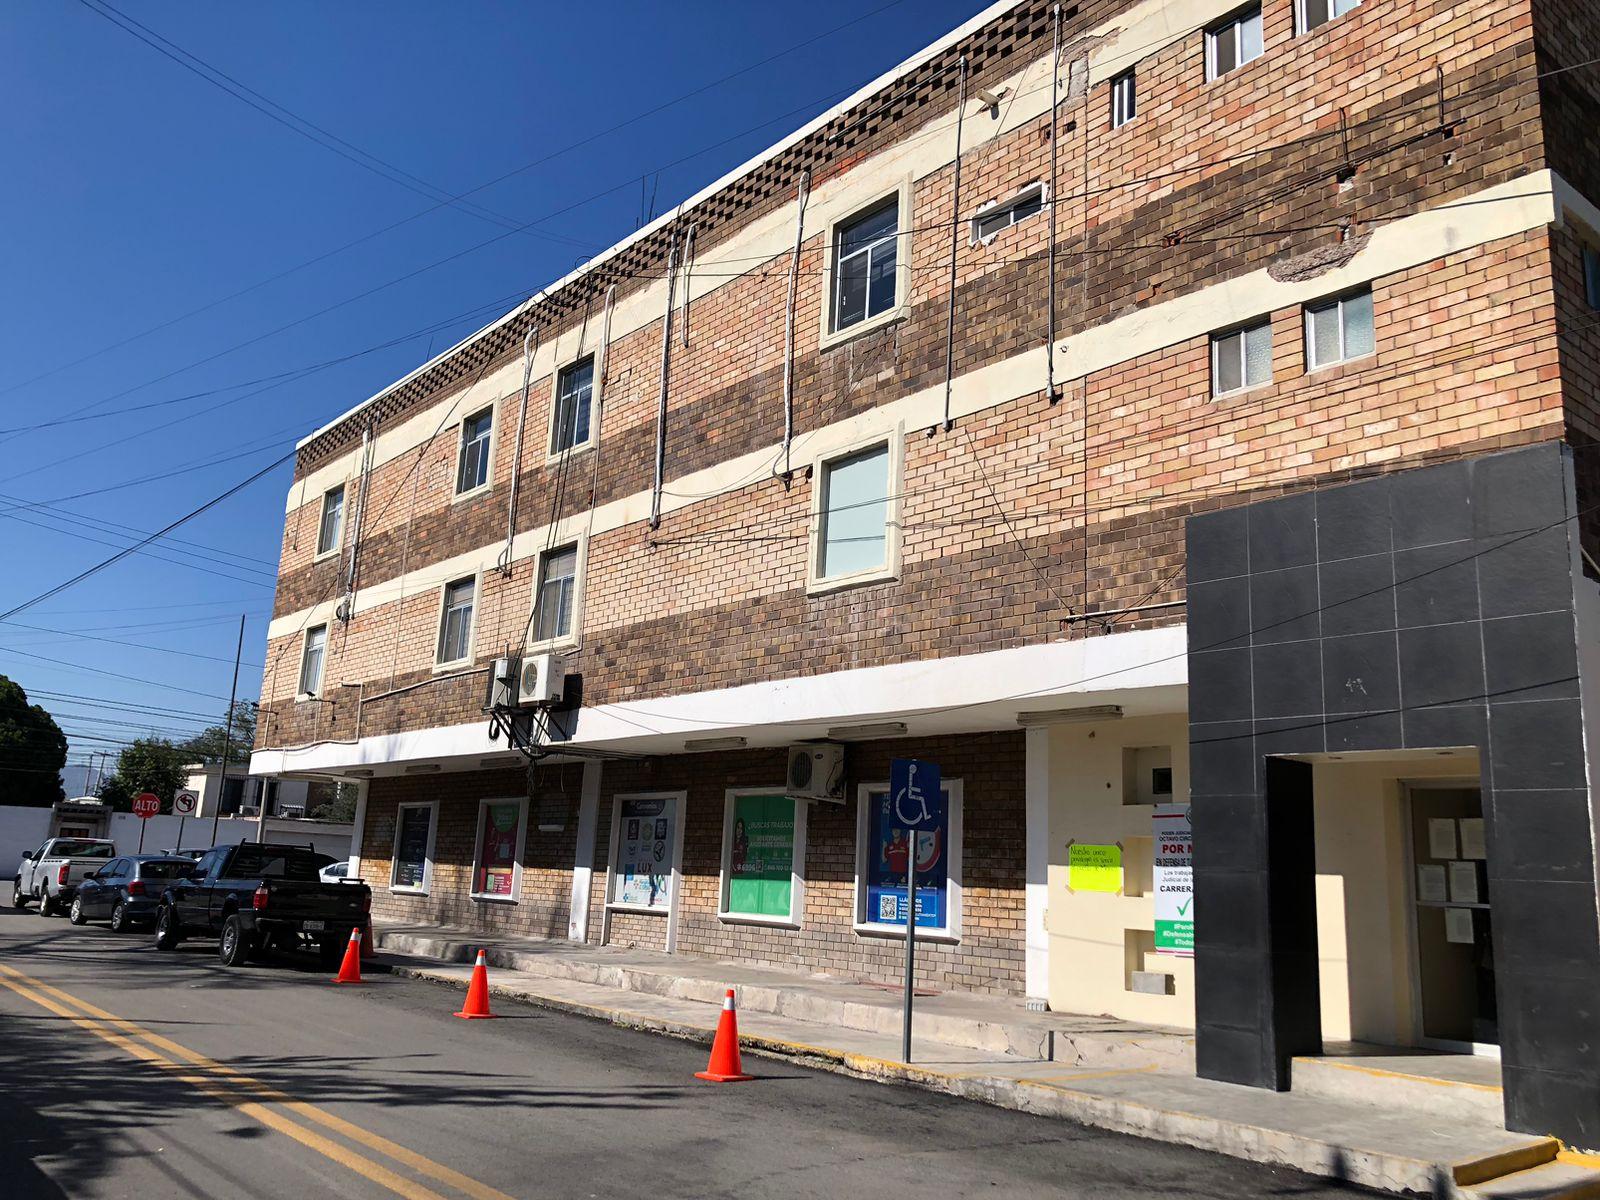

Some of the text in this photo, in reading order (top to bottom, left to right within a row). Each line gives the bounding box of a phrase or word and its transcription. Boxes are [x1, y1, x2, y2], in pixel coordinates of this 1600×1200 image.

[134, 800, 158, 811] ALTO
[1162, 844, 1184, 854] POR
[637, 862, 653, 873] LUX
[1160, 885, 1193, 893] CARRER
